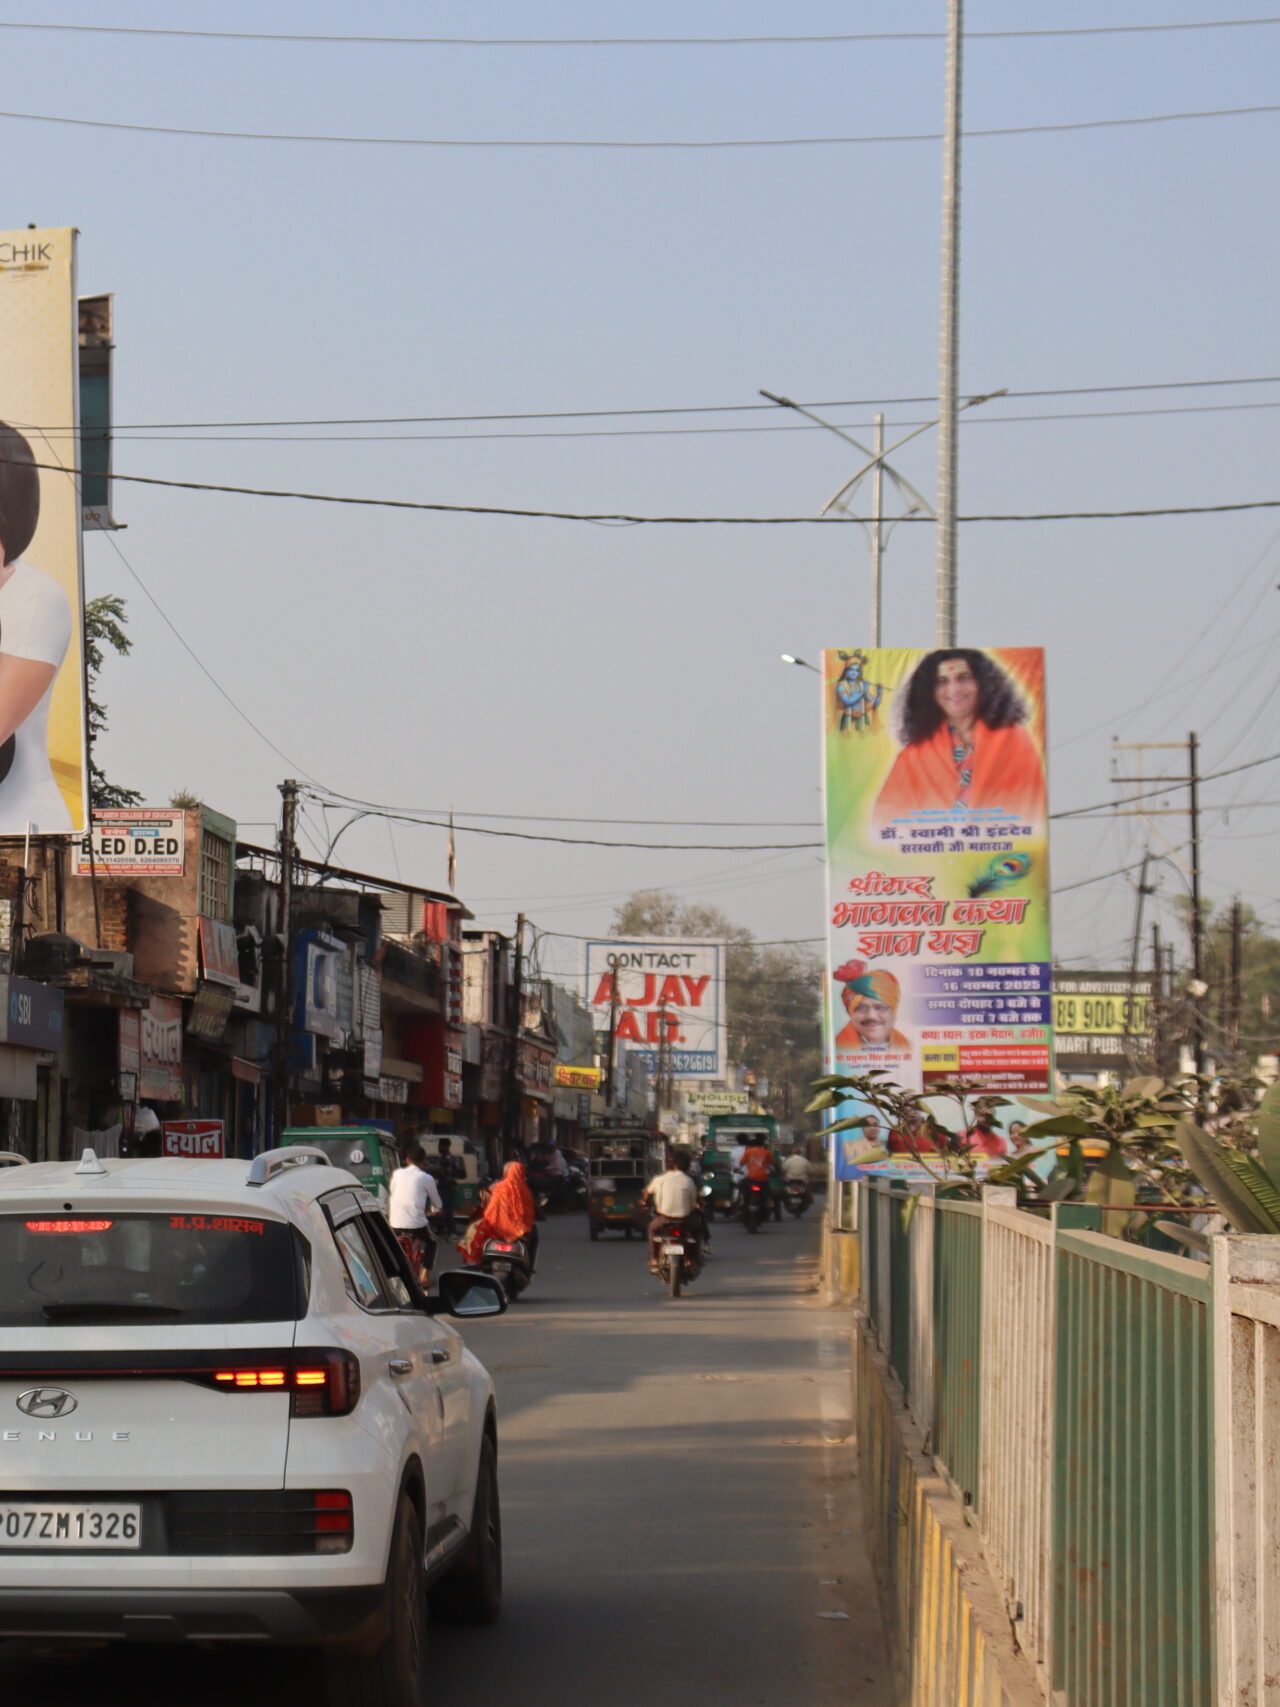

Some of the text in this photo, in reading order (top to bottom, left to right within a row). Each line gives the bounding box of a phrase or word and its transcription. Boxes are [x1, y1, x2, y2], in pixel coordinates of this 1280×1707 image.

[910, 825, 954, 838] स्वामी
[961, 825, 980, 838] श्री
[81, 838, 179, 855] B.ED D.ED
[900, 840, 1013, 853] सरस्वती जी महाराज
[832, 898, 1029, 926] भागवत कथा
[857, 929, 984, 957] ज्ञान यज्ञ
[607, 952, 696, 968] CONTACT
[925, 966, 963, 978] दिनांक
[592, 972, 712, 1007] AJAY
[1004, 981, 1040, 991] 2025
[1060, 982, 1078, 994] FOR
[18, 993, 32, 1026] SBI
[928, 999, 956, 1010] समय
[615, 1011, 687, 1043] AD.
[165, 1129, 221, 1154] दयाल
